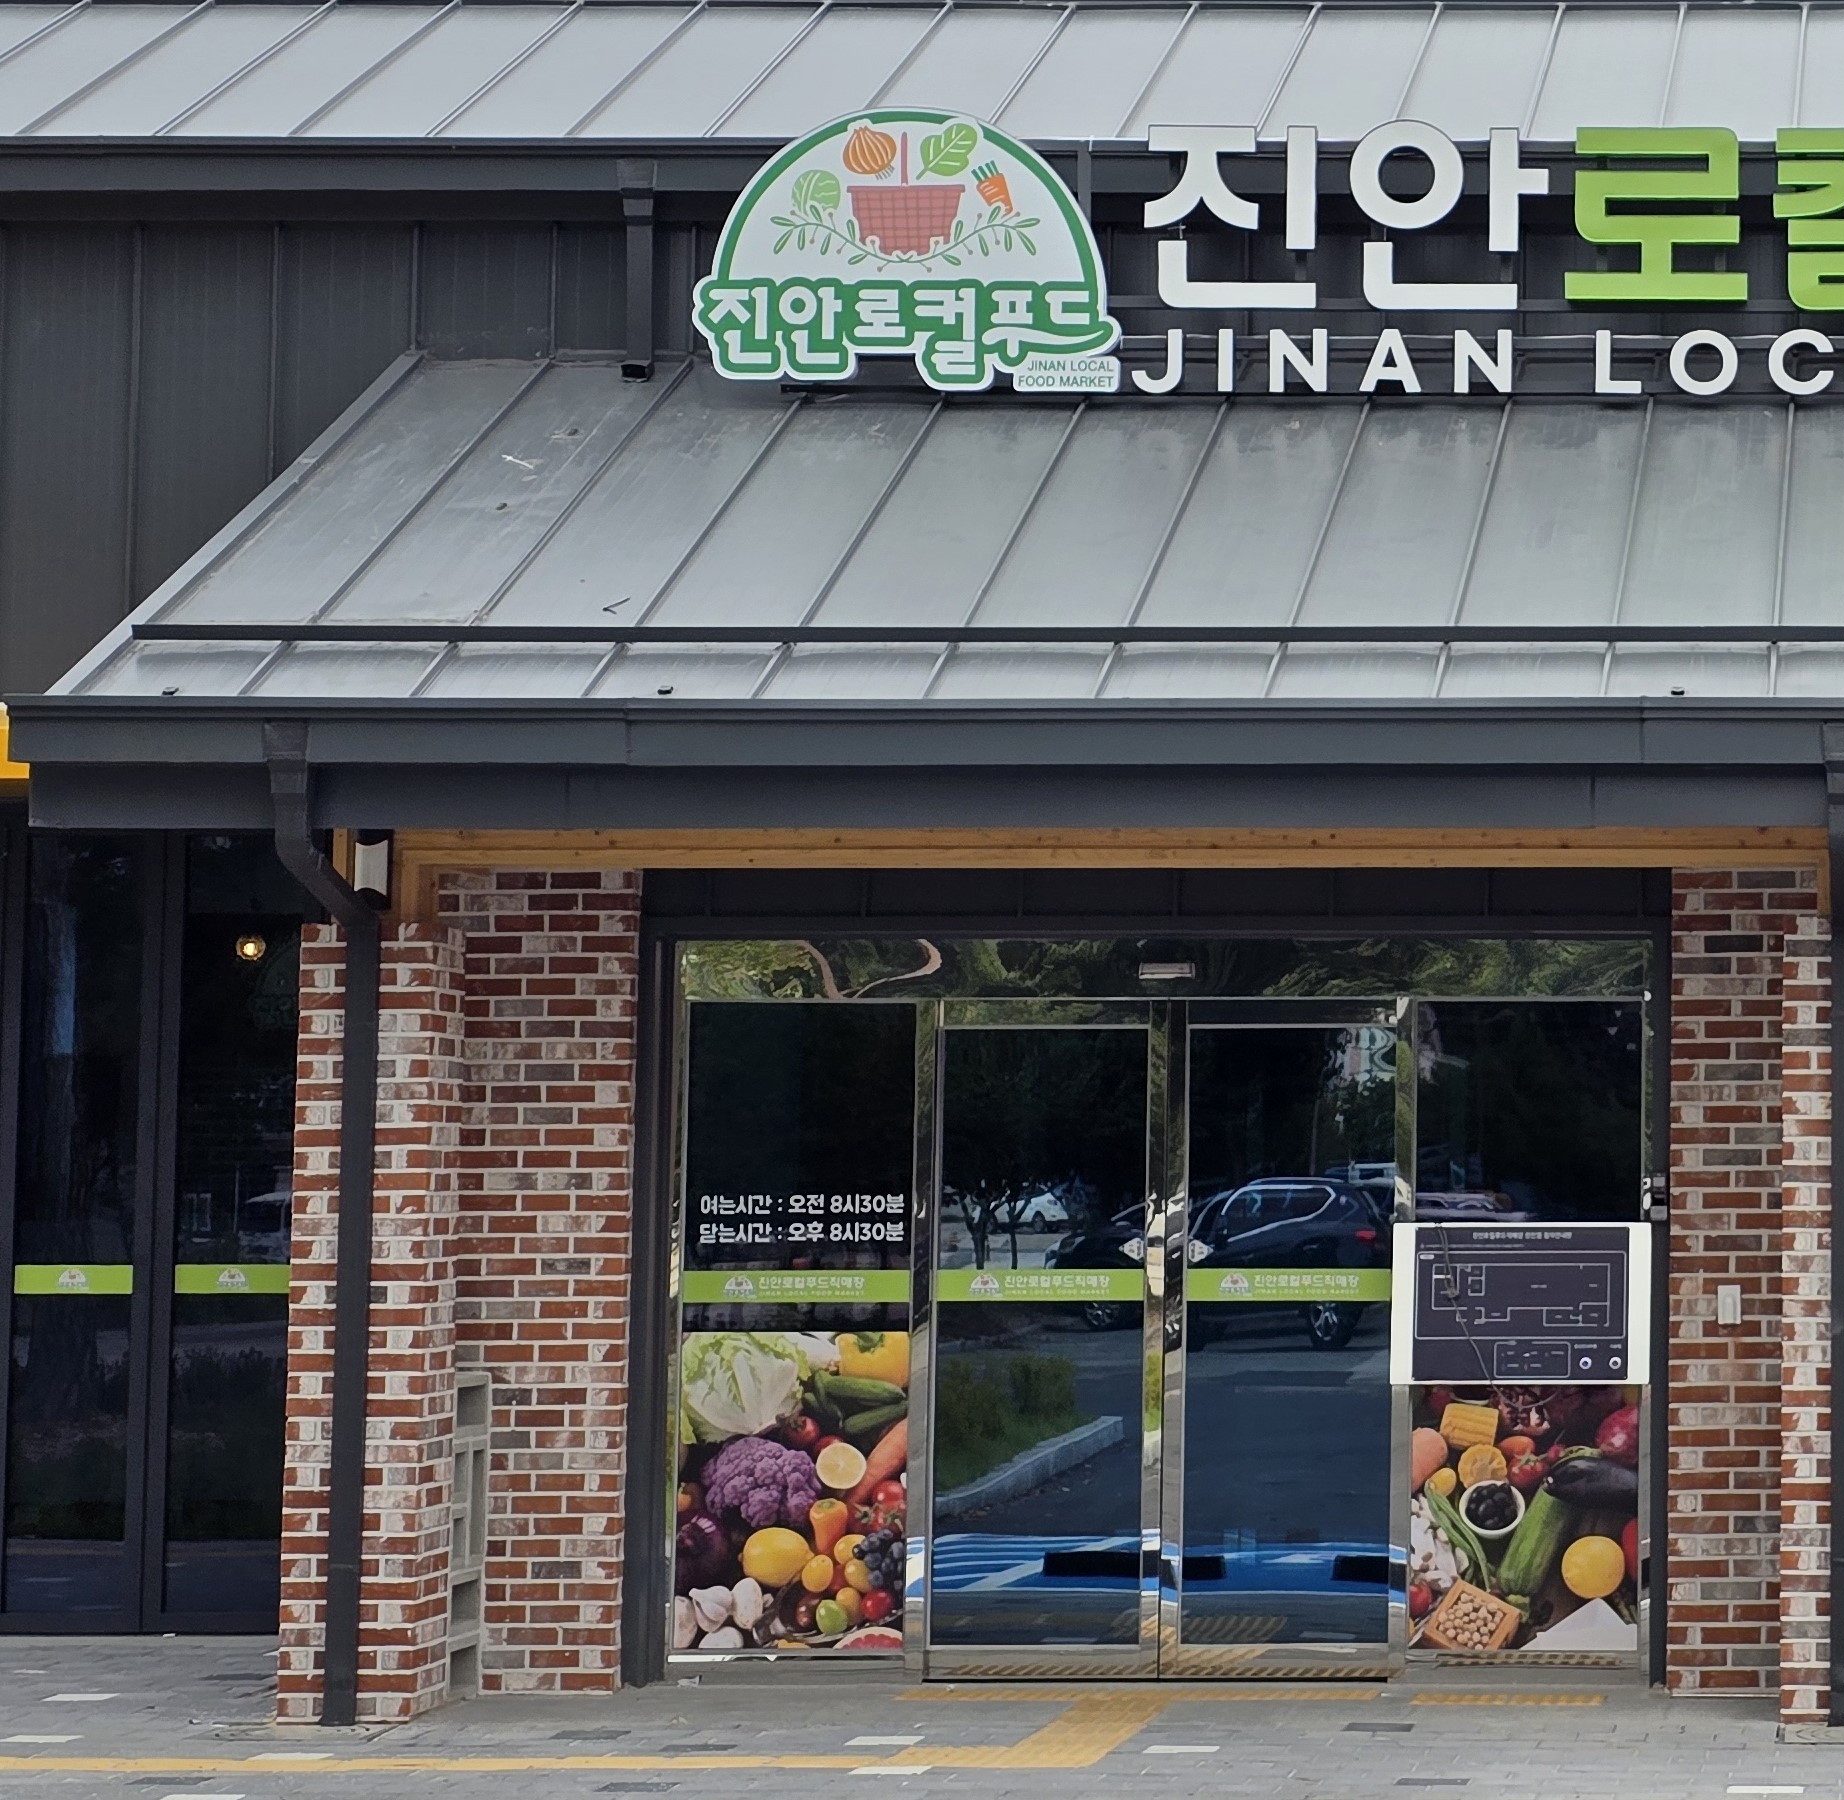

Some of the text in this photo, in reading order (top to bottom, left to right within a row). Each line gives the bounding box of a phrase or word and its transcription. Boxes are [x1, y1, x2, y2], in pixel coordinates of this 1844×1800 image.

[707, 285, 1106, 375] 진안로컬푸드
[1027, 360, 1114, 372] JINAN LOCAL
[1131, 328, 1513, 394] JINAN
[1018, 375, 1114, 387] FOOD MARKET
[700, 1193, 773, 1215] 여는시간
[787, 1193, 825, 1215] 오전
[829, 1193, 905, 1215] 8시30분
[699, 1220, 773, 1244] 닫는시간
[787, 1220, 825, 1243] 오후
[829, 1220, 905, 1243] 8시30분
